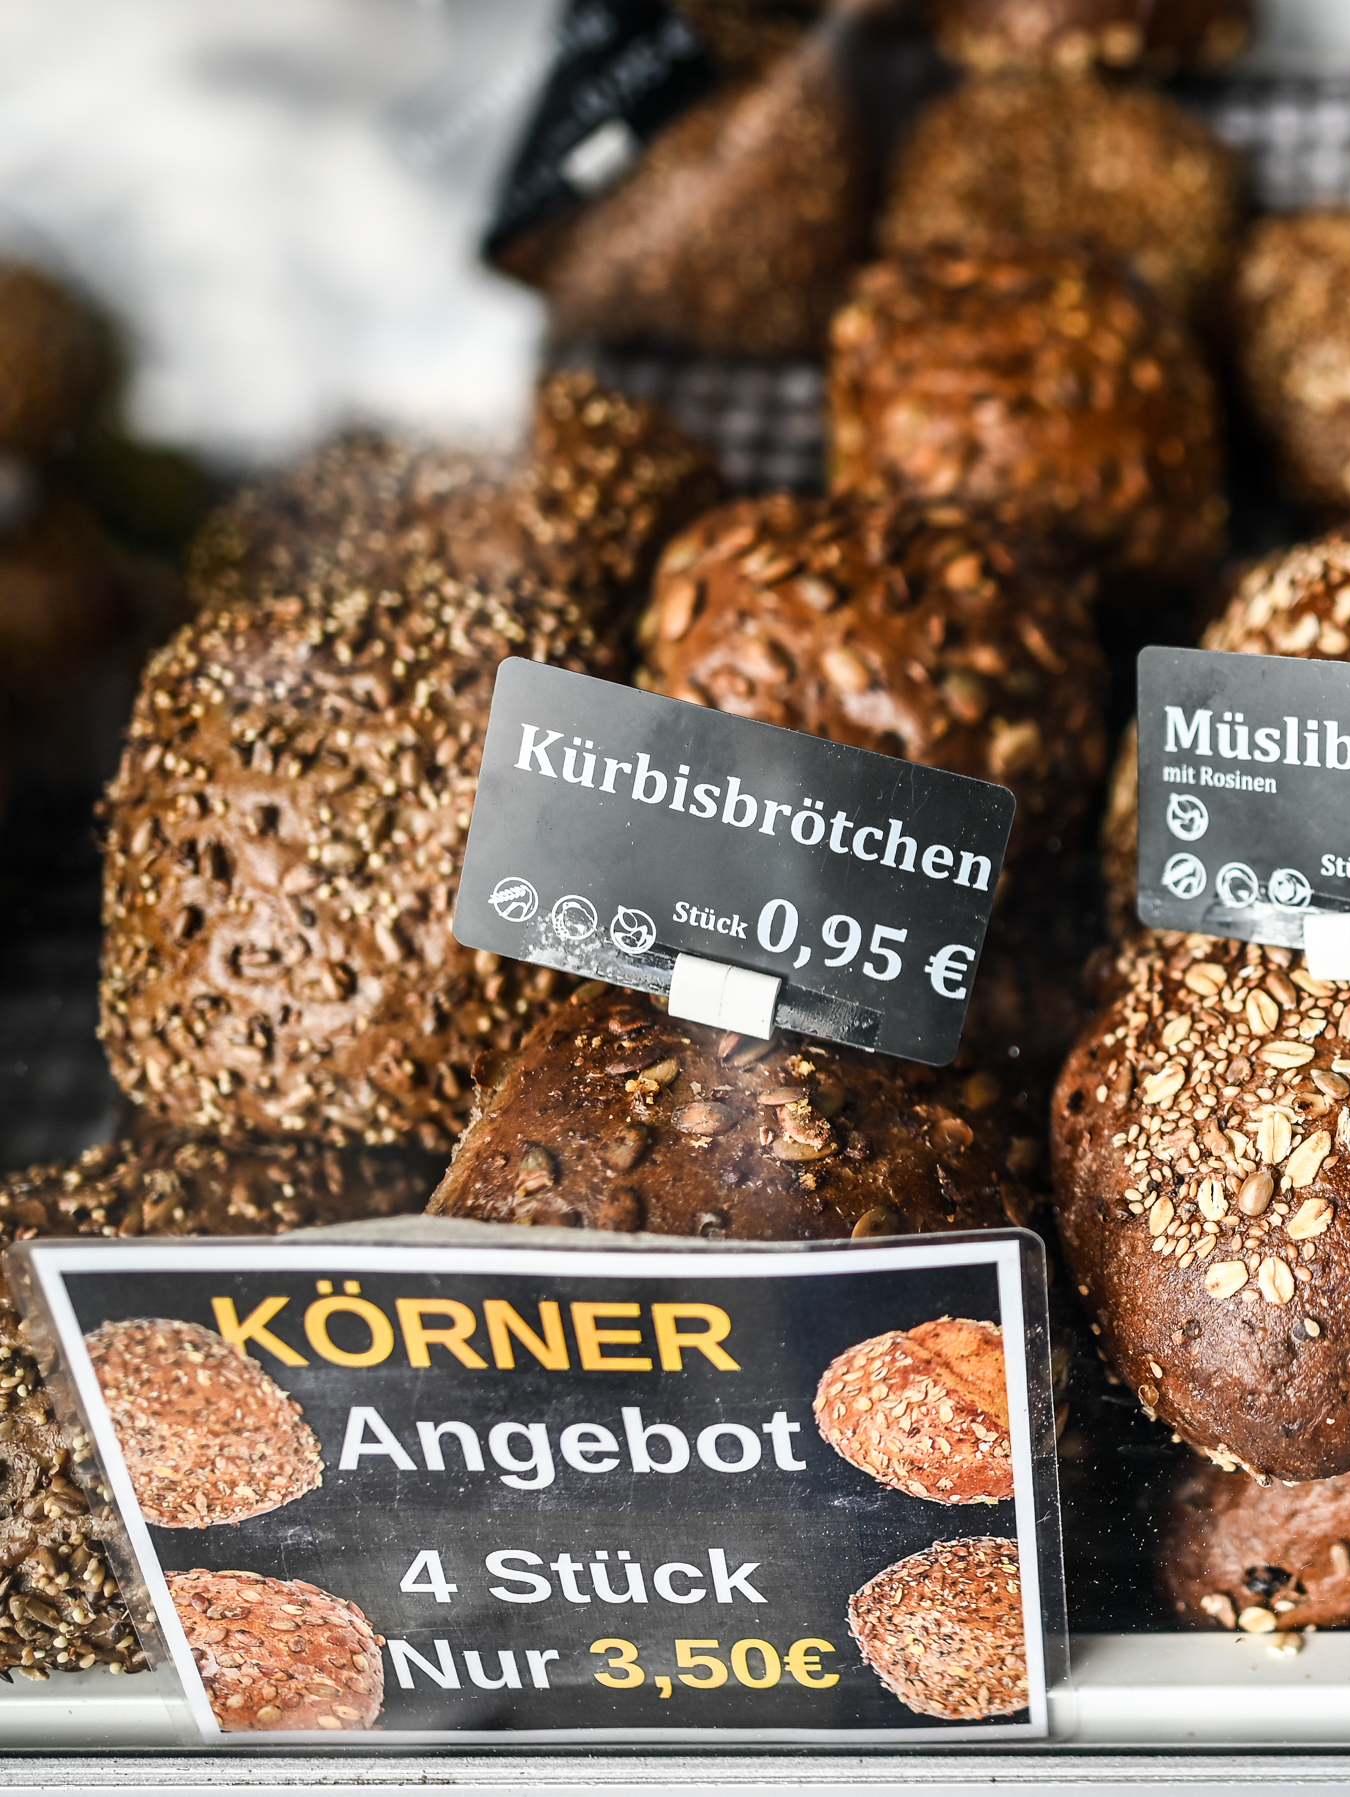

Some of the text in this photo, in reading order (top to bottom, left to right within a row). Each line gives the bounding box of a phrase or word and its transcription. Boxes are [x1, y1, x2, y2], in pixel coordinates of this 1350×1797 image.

[514, 723, 992, 891] Kürbisbrötchen
[1163, 764, 1277, 794] mit Rosinen
[673, 898, 976, 1000] Stück 0,95 €
[210, 1280, 742, 1372] KÖRNER
[338, 1406, 807, 1491] Angebot
[400, 1548, 768, 1604] 4 Stück
[388, 1637, 841, 1700] Nur 3,50€
